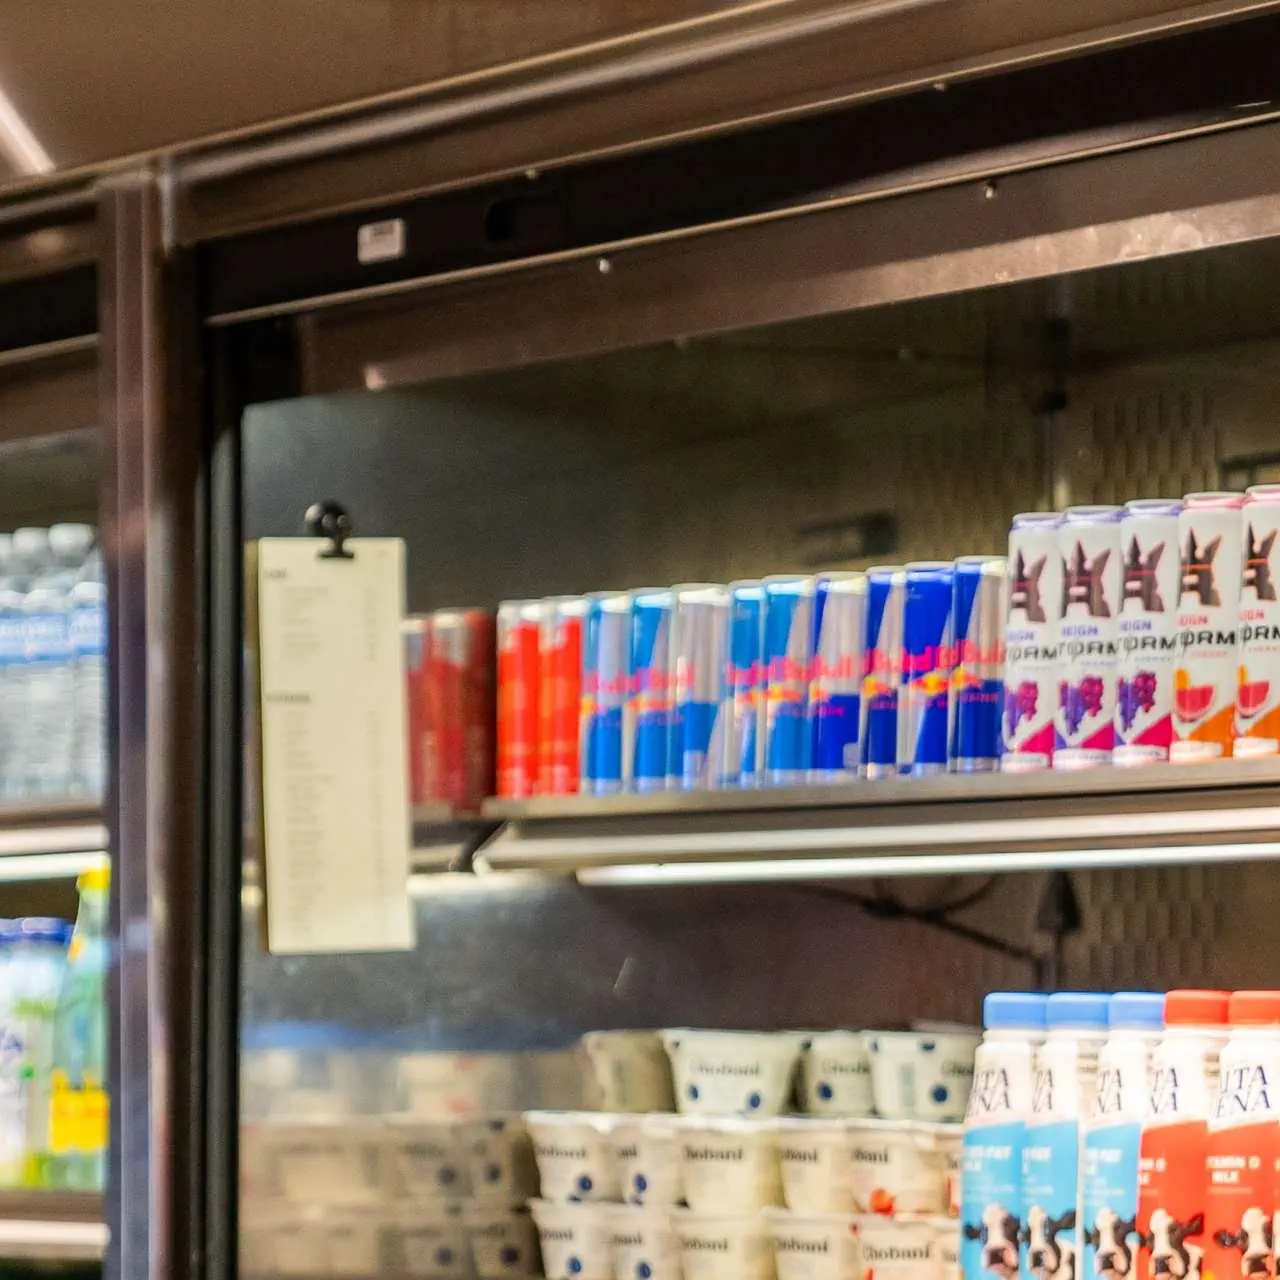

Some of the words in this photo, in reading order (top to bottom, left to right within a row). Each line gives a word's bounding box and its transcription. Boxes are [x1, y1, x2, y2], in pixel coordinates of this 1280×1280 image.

[1120, 635, 1175, 653] ORM
[1179, 630, 1236, 649] ORM
[1061, 639, 1117, 659] ORM
[683, 1145, 744, 1161] hobani
